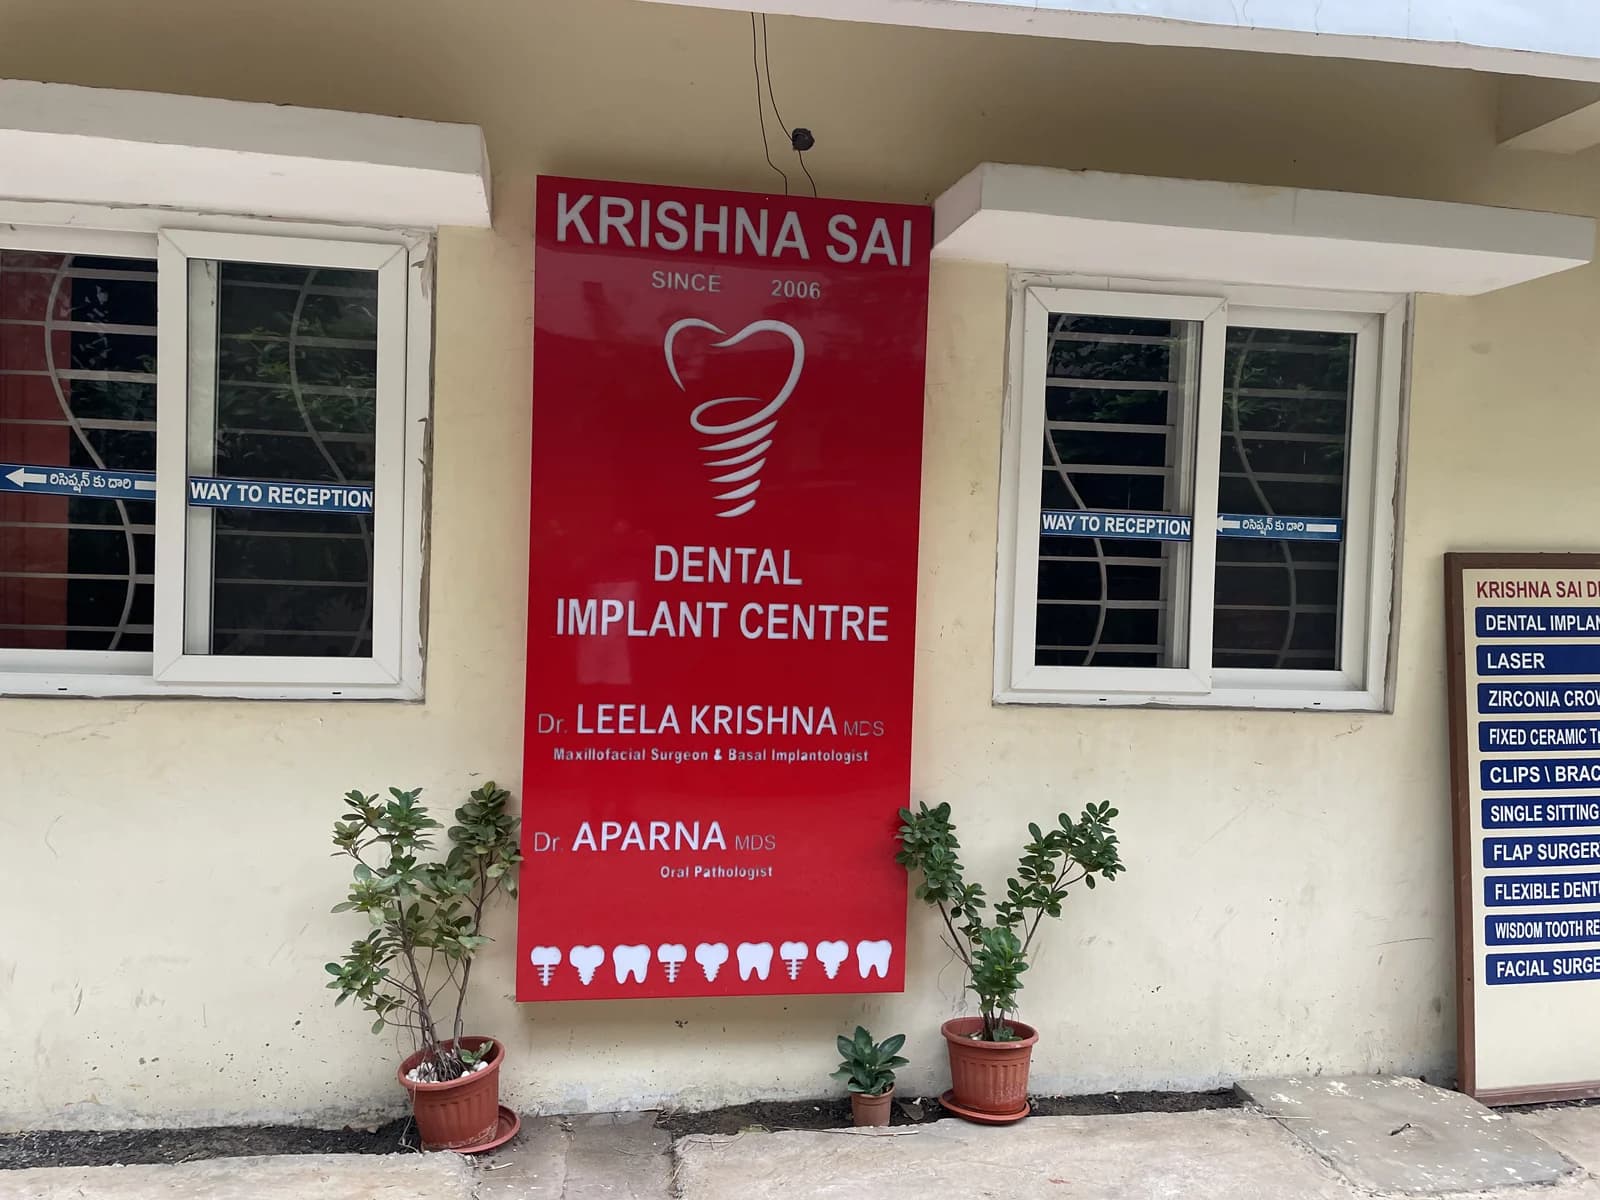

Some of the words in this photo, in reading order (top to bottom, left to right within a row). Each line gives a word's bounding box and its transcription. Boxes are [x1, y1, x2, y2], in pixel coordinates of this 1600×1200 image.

[557, 193, 810, 260] KRISHNA
[826, 214, 912, 267] SAI
[651, 271, 721, 293] SINCE
[771, 279, 821, 299] 2006
[93, 475, 105, 488] కు
[108, 477, 132, 489] దారి
[191, 482, 232, 501] WAY
[236, 484, 263, 502] TO
[268, 487, 374, 508] RECEPTION
[1042, 514, 1076, 530] WAY
[1080, 516, 1100, 532] TO
[1104, 517, 1191, 536] RECEPTION
[654, 544, 802, 586] DENTAL
[1477, 581, 1551, 598] KRISHNA
[1556, 581, 1582, 598] SAI
[556, 598, 728, 638] IMPLANT
[739, 602, 889, 643] CENTRE
[1486, 614, 1547, 631] DENTAL
[1487, 653, 1545, 669] LASER
[1488, 690, 1560, 707] ZIRCONIA
[538, 713, 567, 734] Dr.
[577, 703, 681, 735] LEELA
[691, 704, 838, 736] KRISHNA
[844, 720, 885, 737] MDS
[1489, 728, 1527, 745] FIXED
[1530, 727, 1587, 745] CERAMIC
[553, 747, 646, 762] Maxillofacial
[651, 747, 709, 764] Surgeon
[713, 748, 723, 761] &
[728, 748, 767, 762] Basal
[772, 748, 868, 765] Implantologist
[1490, 766, 1540, 784] CLIPS
[1543, 766, 1550, 783] \
[1555, 764, 1600, 783] BRAC
[1490, 805, 1543, 822] SINGLE
[1546, 803, 1599, 821] SITTING
[571, 821, 727, 852] APARNA
[735, 834, 776, 851] MDS
[1493, 844, 1533, 861] FLAP
[1537, 842, 1600, 861] SURGER
[660, 865, 689, 879] Oral
[694, 865, 773, 881] Pathologist
[1495, 882, 1560, 900] FLEXIBLE
[1563, 880, 1600, 899] DENT
[1495, 921, 1542, 939] WISDOM
[1545, 920, 1583, 938] TOOTH
[1496, 960, 1548, 978] FACIAL
[1553, 957, 1600, 976] SURGE
